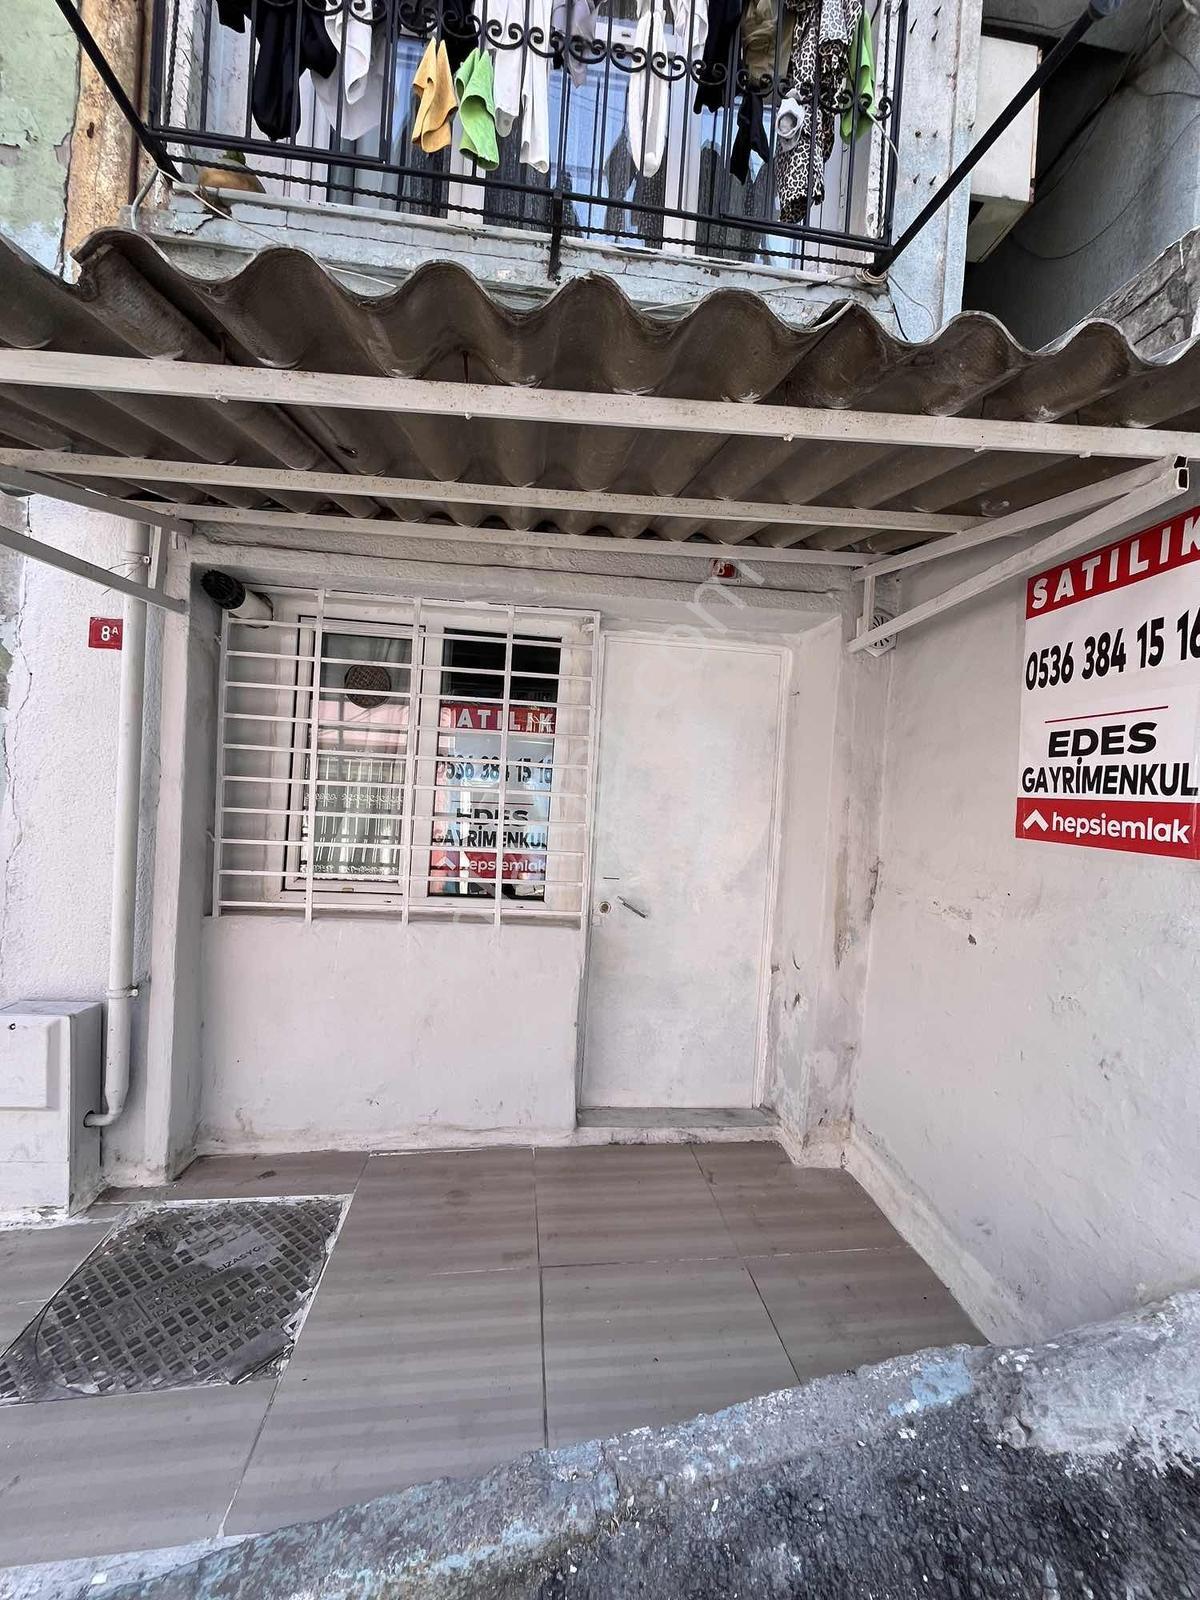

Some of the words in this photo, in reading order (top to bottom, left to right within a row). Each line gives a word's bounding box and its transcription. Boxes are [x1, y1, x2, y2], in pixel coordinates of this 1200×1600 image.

[1031, 515, 1200, 610] SATILIK
[1025, 641, 1075, 691] 0536
[1081, 627, 1127, 680] 384
[1137, 616, 1165, 669] 15
[1048, 721, 1158, 758] EDES
[1022, 757, 1199, 797] GAYRİMENKUL
[1052, 811, 1191, 845] hepsiemlak
